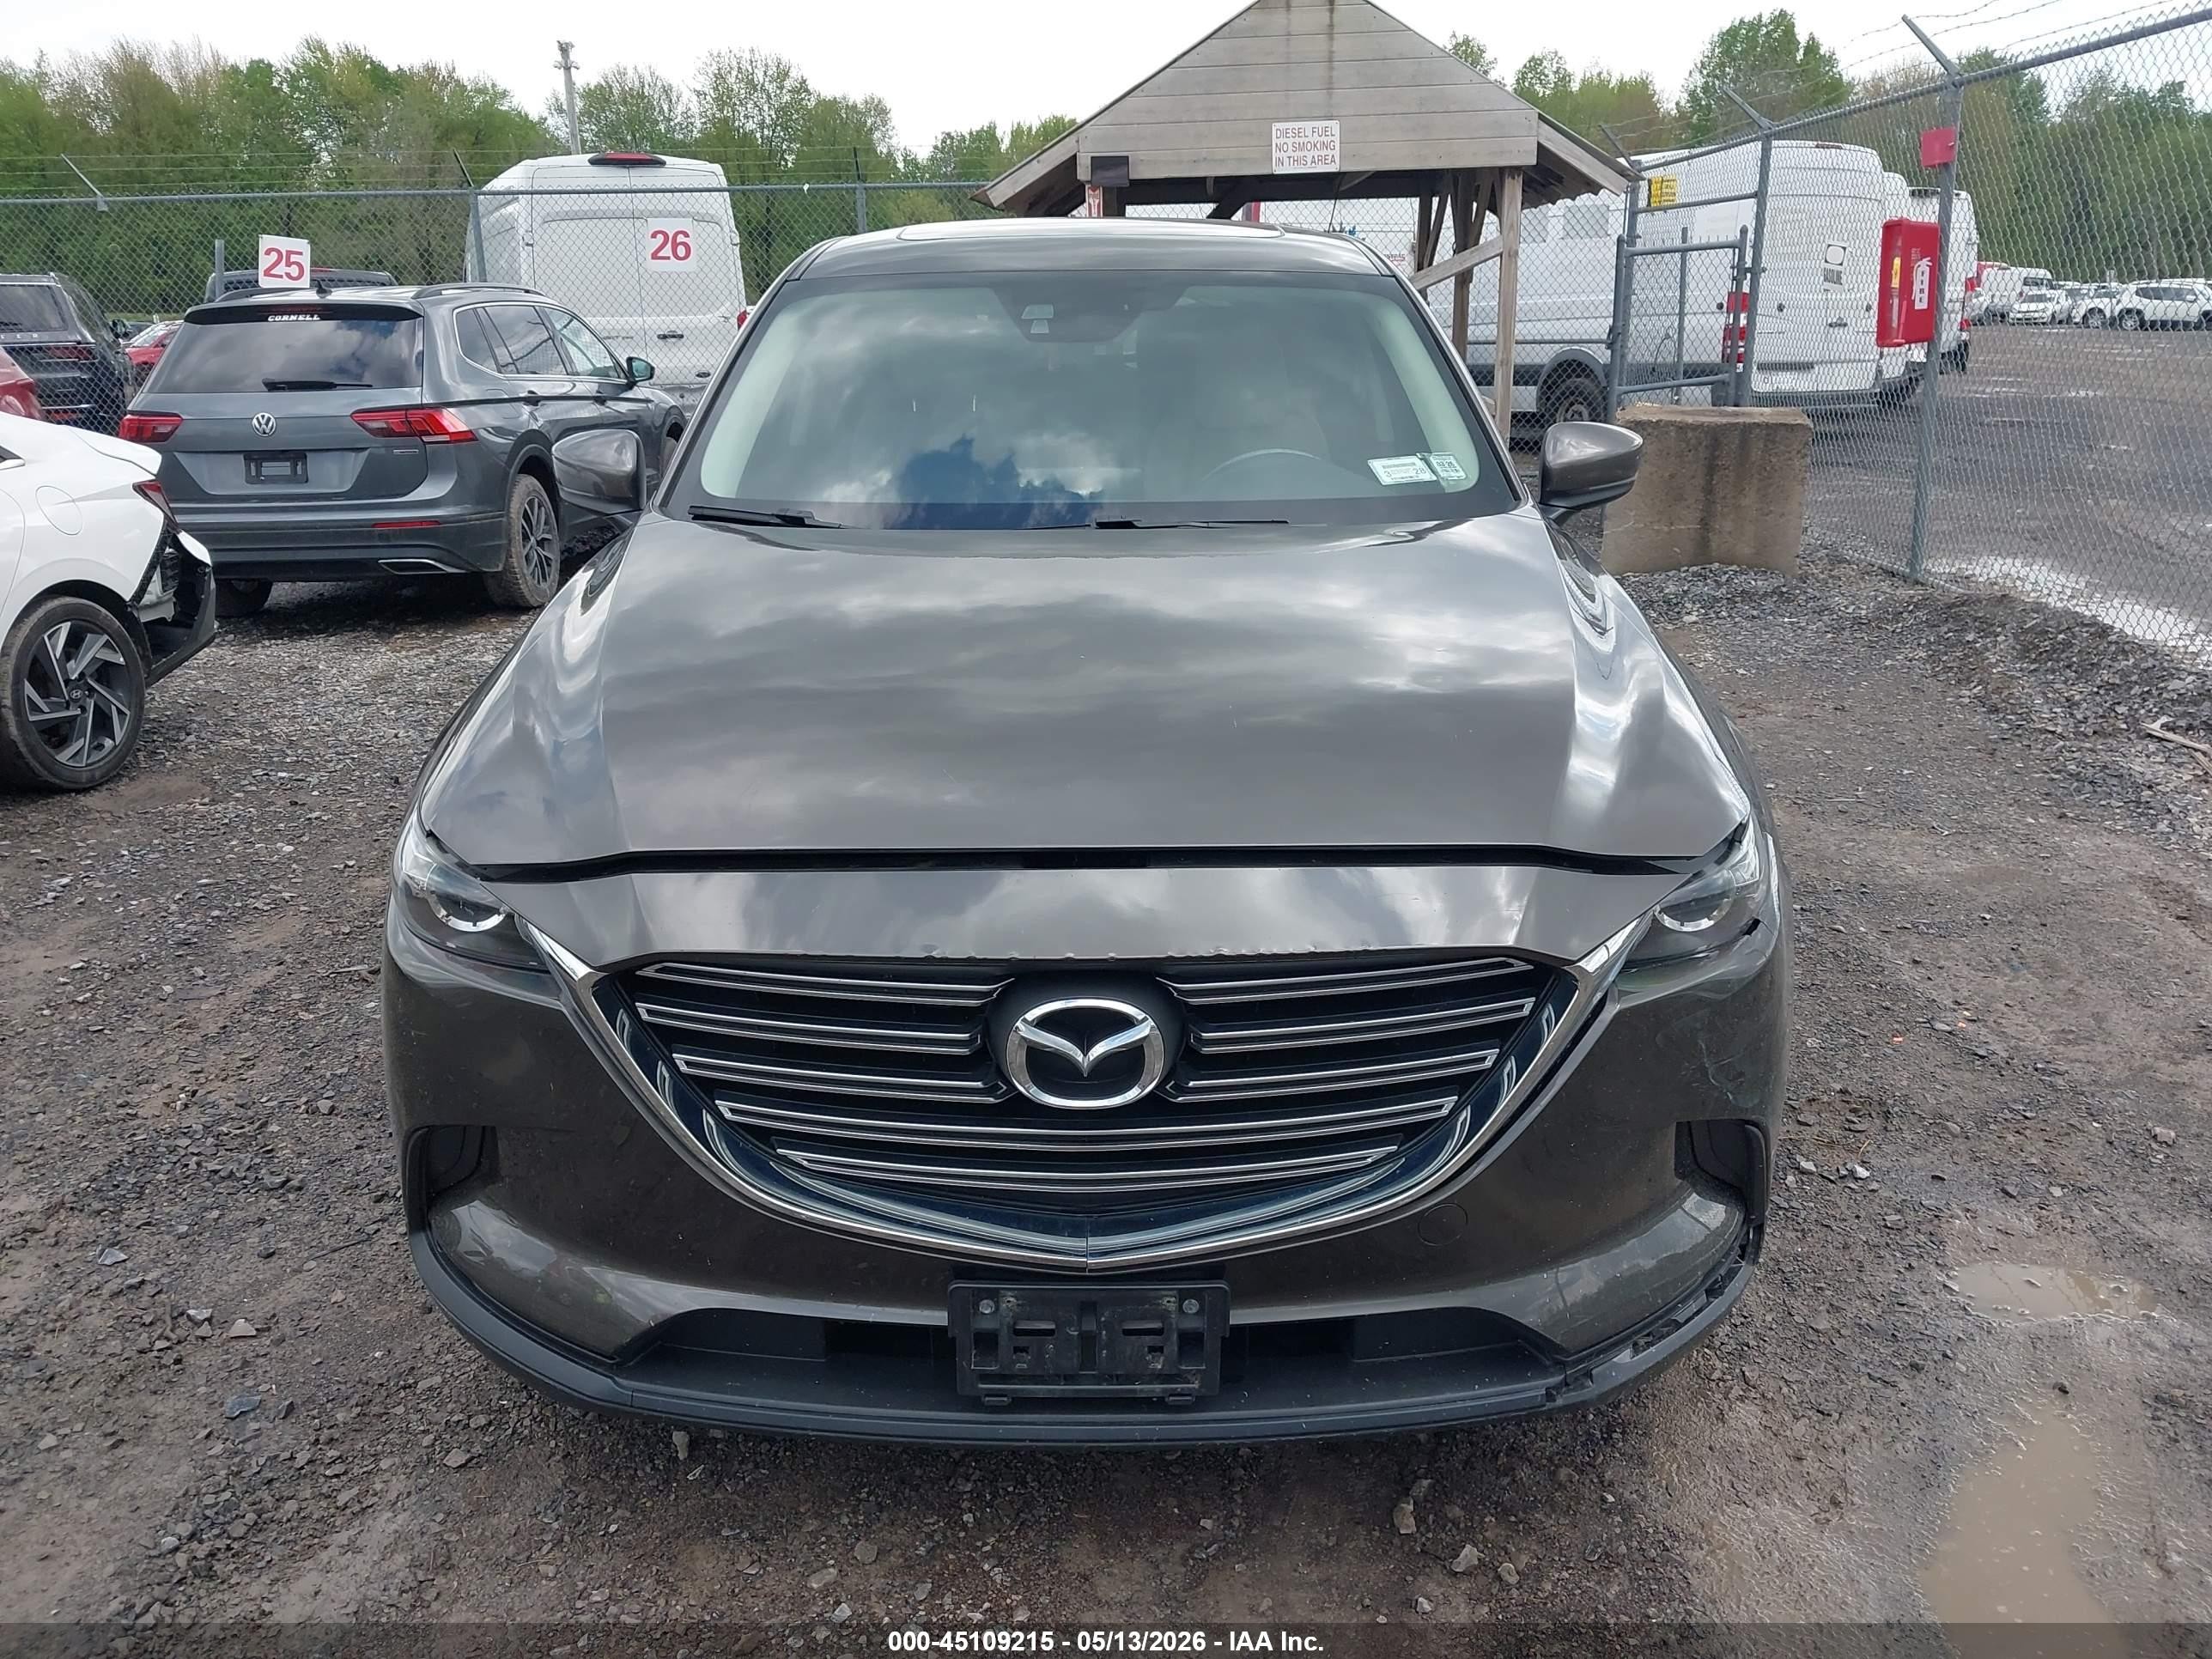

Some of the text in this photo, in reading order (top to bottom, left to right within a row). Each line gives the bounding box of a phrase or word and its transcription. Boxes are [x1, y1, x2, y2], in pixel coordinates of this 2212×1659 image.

[1275, 125, 1335, 139] DIESEL FUEL
[1275, 140, 1336, 153] NO SMOKING
[1275, 155, 1336, 167] IN THIS AREA
[650, 229, 691, 261] 26
[263, 247, 305, 282] 25
